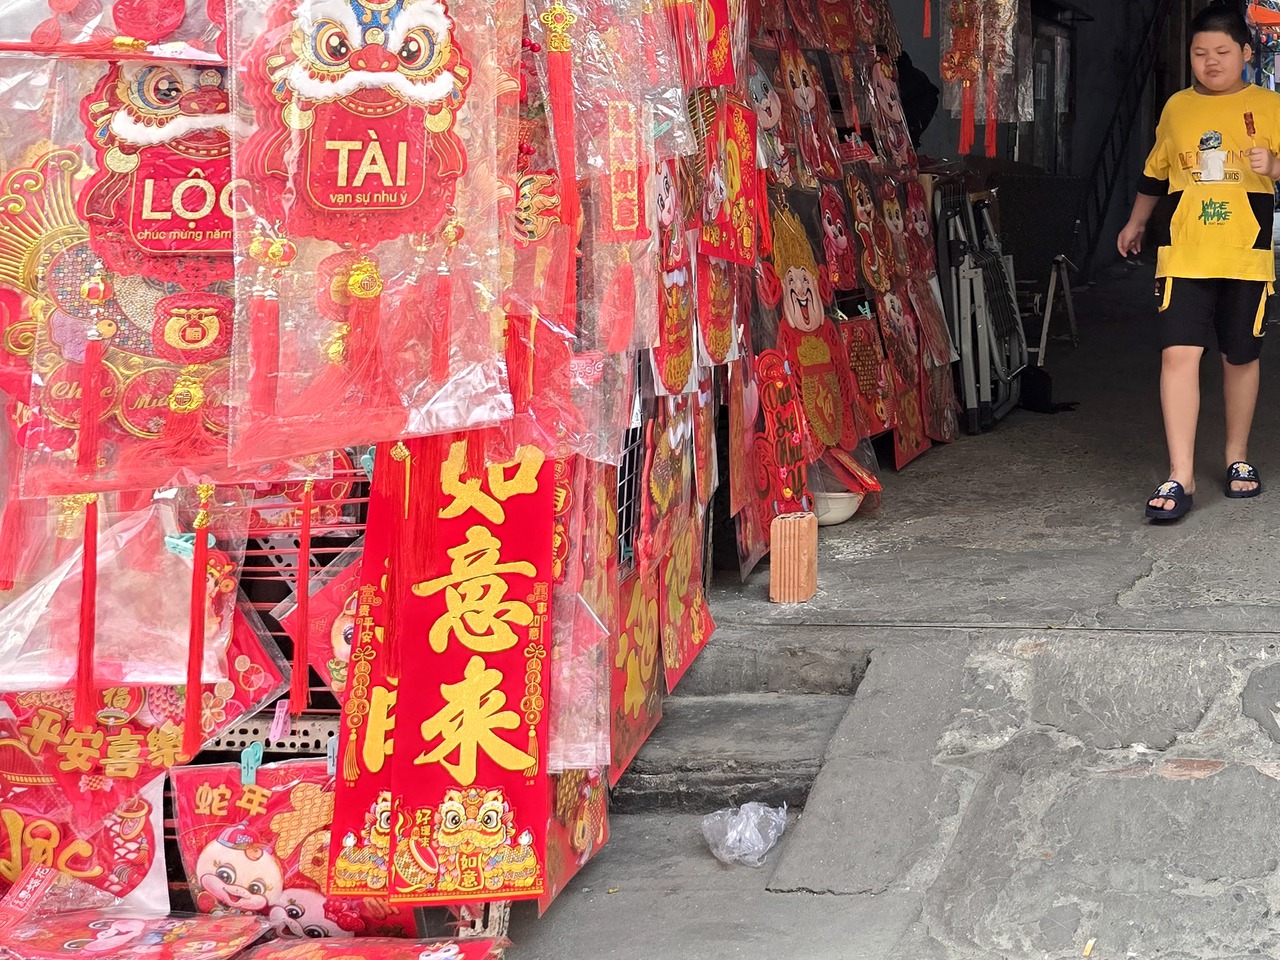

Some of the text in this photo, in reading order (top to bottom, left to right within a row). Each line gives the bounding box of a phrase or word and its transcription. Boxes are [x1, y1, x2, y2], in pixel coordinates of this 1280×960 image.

[325, 129, 408, 187] TÀI
[142, 167, 252, 228] LỘC
[329, 193, 352, 206] vạn
[356, 192, 371, 205] sự
[373, 190, 398, 203] như
[137, 228, 167, 240] chúc
[168, 228, 203, 242] mừng
[213, 227, 232, 240] năm
[51, 380, 113, 400] Chc
[194, 783, 272, 817] 蛇年
[460, 854, 479, 888] 如意
